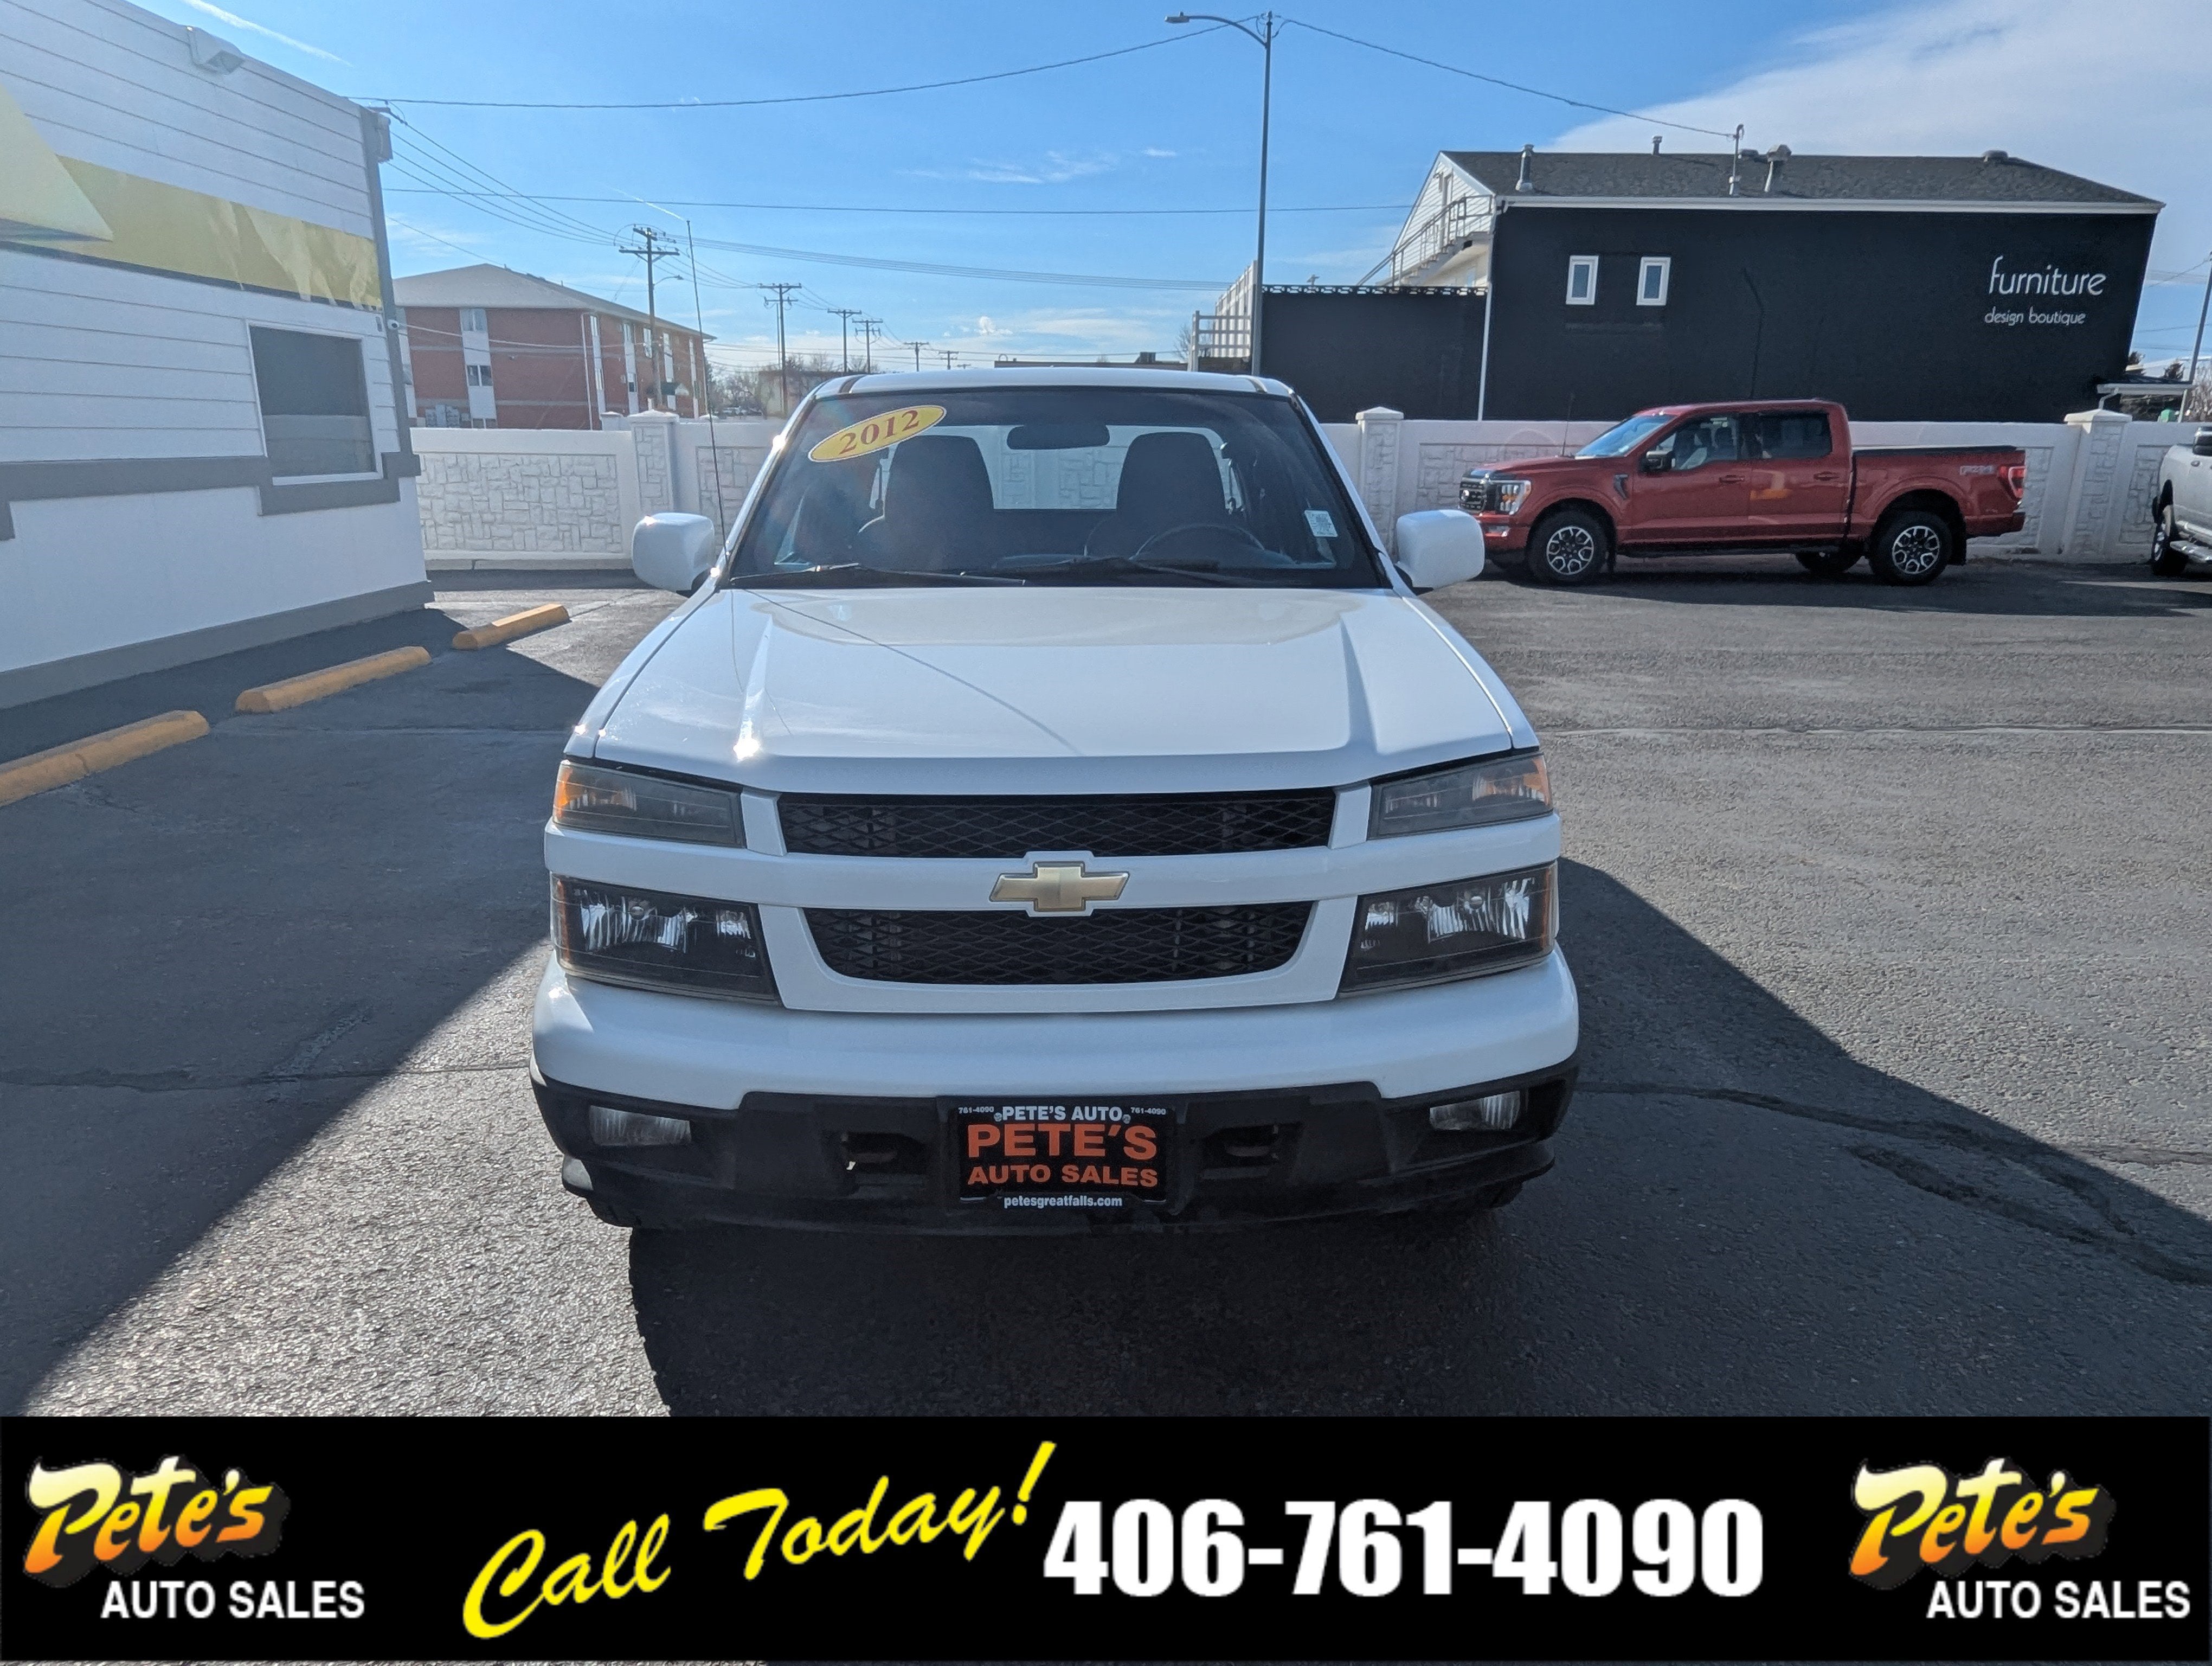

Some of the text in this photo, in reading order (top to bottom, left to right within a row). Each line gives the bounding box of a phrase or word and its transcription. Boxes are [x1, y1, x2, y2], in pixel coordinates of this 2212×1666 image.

[1988, 255, 2107, 296] furniture
[1984, 306, 2086, 326] design boutique
[839, 410, 920, 454] 2012
[1002, 1106, 1122, 1122] PETE'S AUTO
[1130, 1107, 1166, 1115] 761-4090
[967, 1123, 1158, 1161] PETE'S
[967, 1164, 1158, 1188] AUTO SALES
[1004, 1195, 1123, 1209] petesgreatfalls.com
